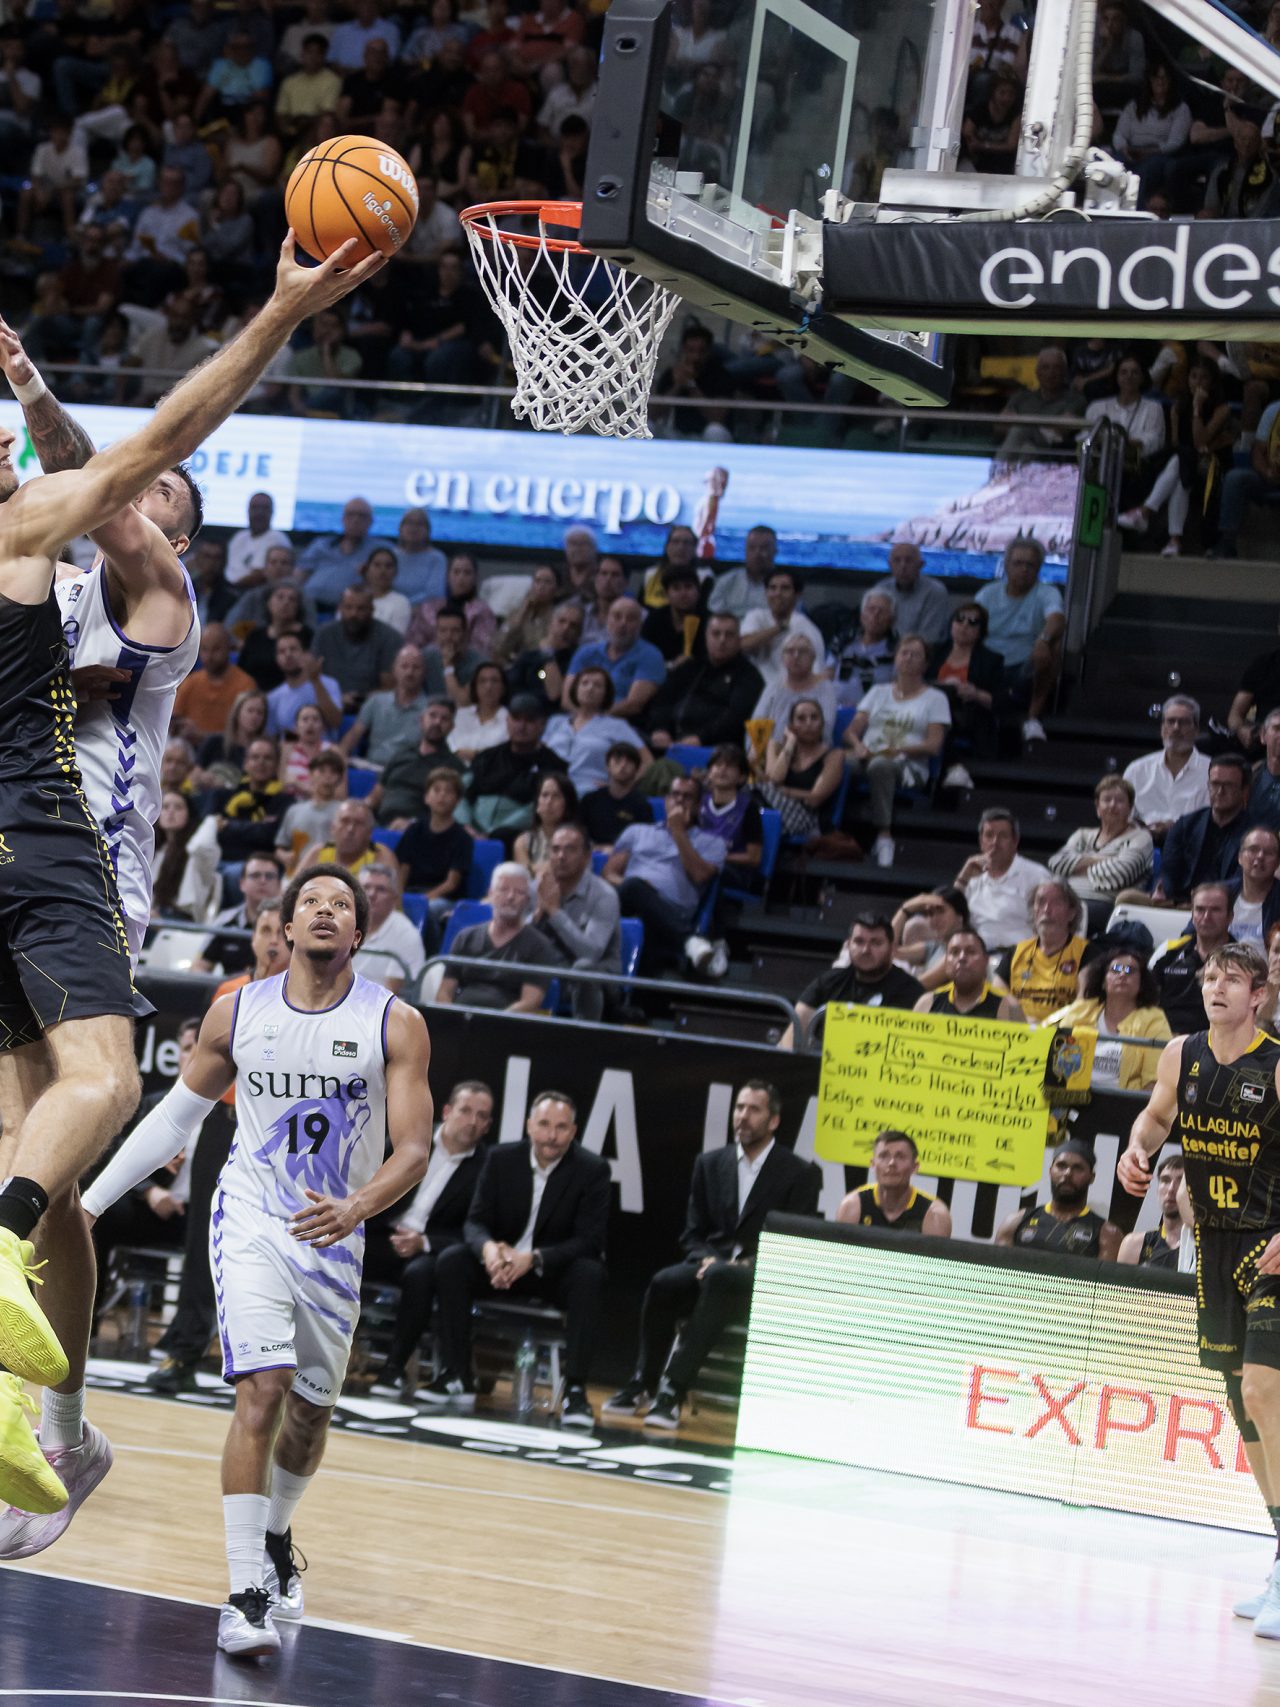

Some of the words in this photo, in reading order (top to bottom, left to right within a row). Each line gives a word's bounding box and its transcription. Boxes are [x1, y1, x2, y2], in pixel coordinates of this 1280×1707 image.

[405, 469, 470, 511] en
[485, 473, 682, 535] cuerpo
[247, 1070, 368, 1100] surne
[285, 1113, 330, 1155] 19
[1180, 1111, 1196, 1130] LA
[1197, 1115, 1261, 1139] LAGUNA
[1208, 1175, 1240, 1209] 42
[261, 1345, 271, 1353] EL
